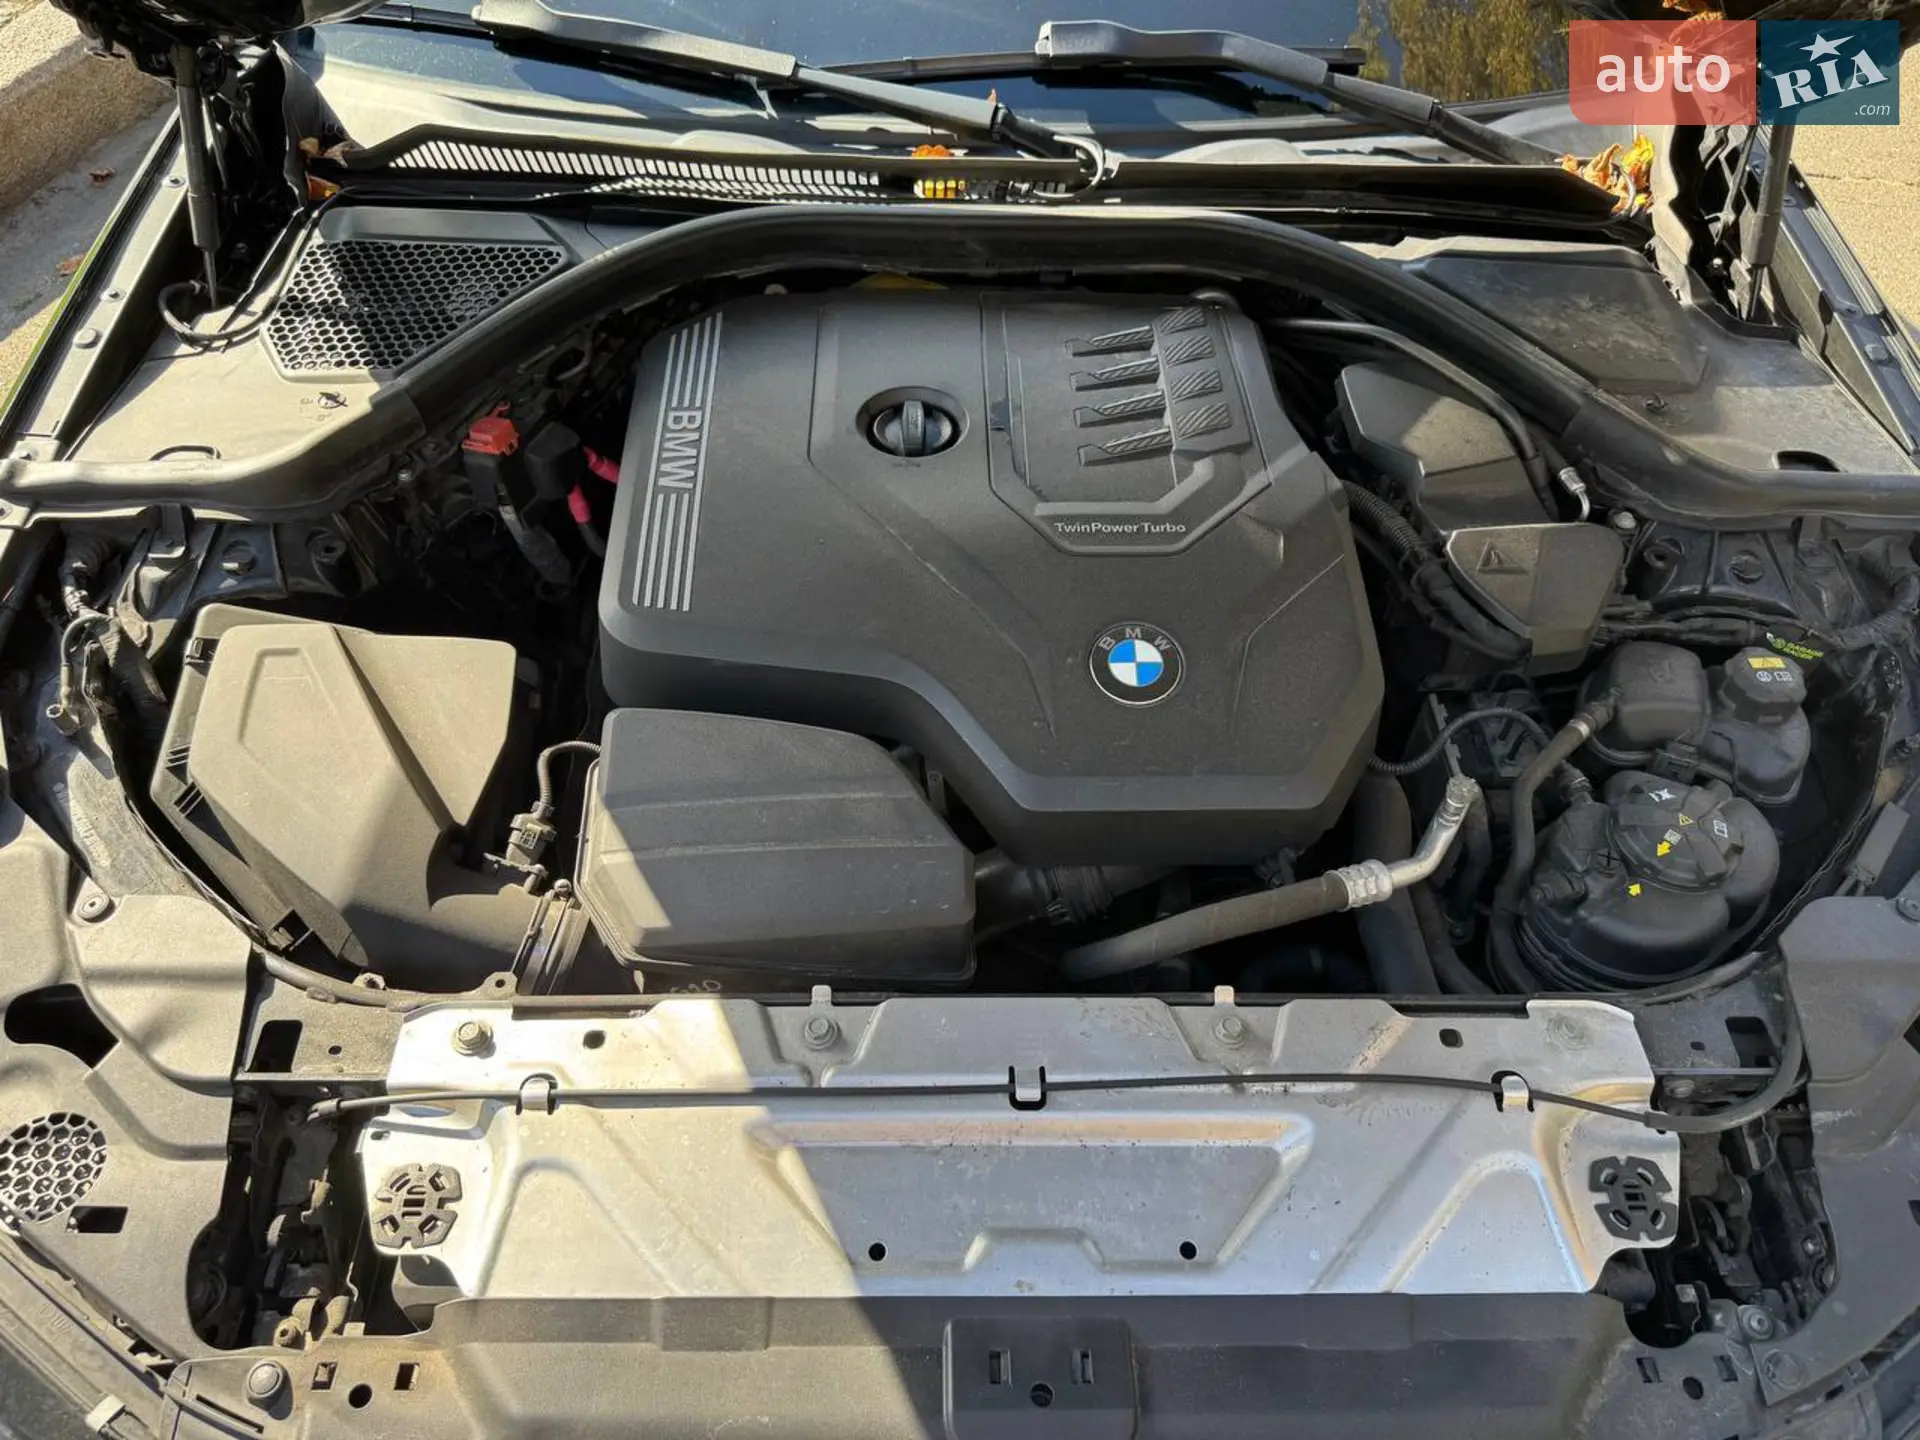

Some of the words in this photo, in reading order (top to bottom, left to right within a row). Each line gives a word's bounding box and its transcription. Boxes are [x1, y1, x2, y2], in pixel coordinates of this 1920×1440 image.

[658, 410, 702, 488] BMW
[1054, 522, 1140, 533] TwinPower
[1140, 522, 1187, 533] Turbo
[1098, 626, 1171, 651] BMW
